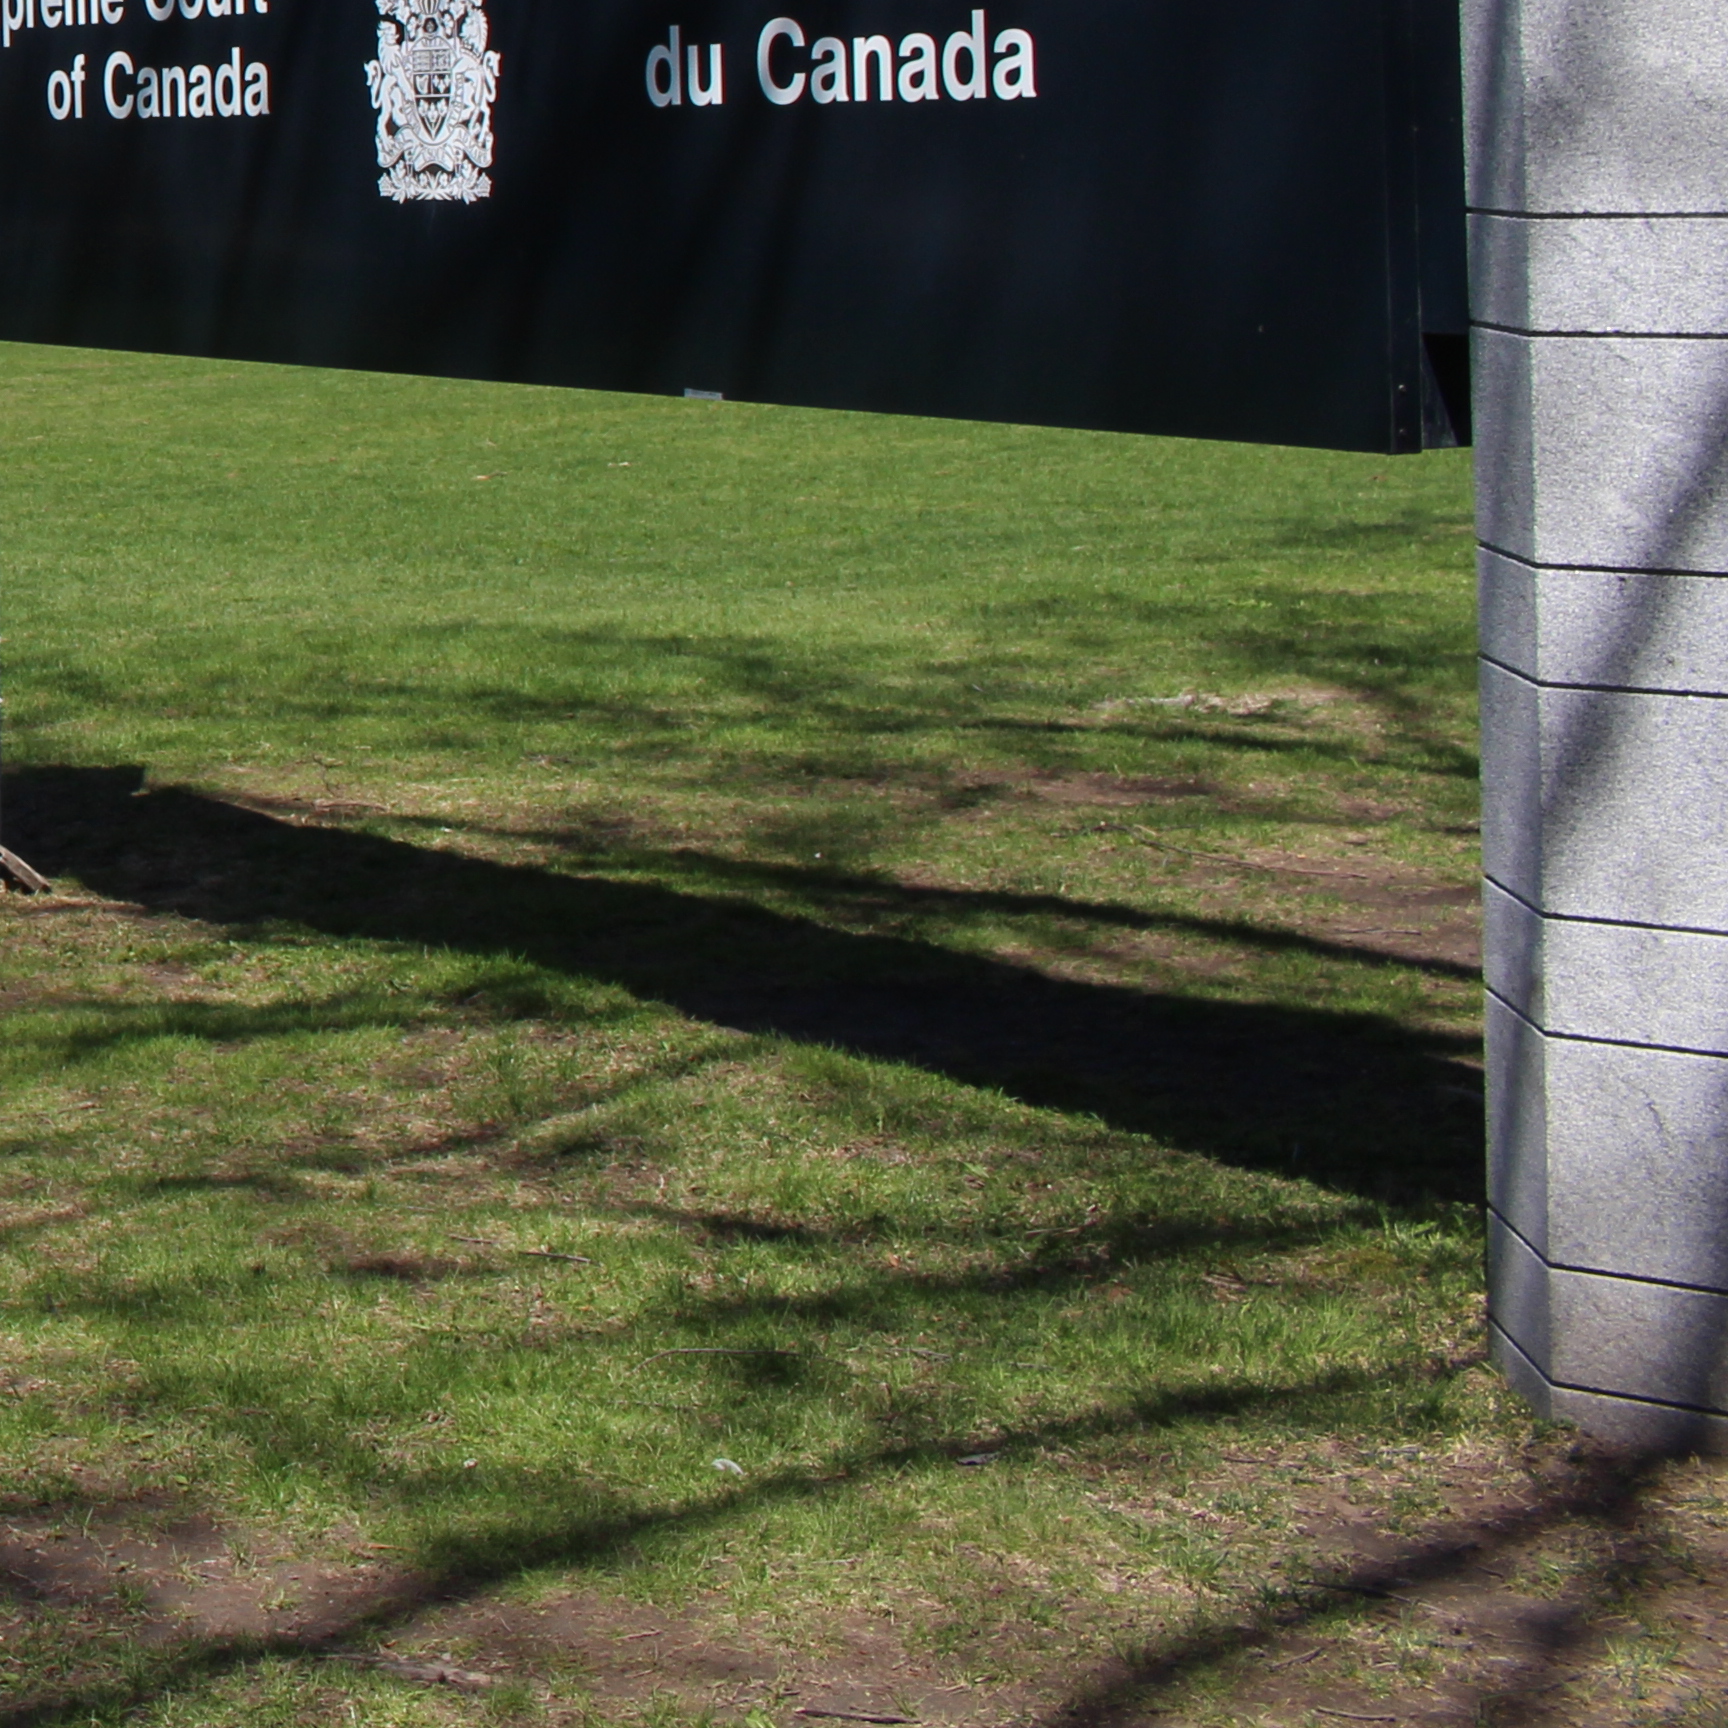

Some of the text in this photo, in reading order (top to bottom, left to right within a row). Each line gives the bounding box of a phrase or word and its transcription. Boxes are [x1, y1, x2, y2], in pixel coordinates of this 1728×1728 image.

[46, 46, 270, 120] of Canada
[645, 7, 1038, 108] du Canada
